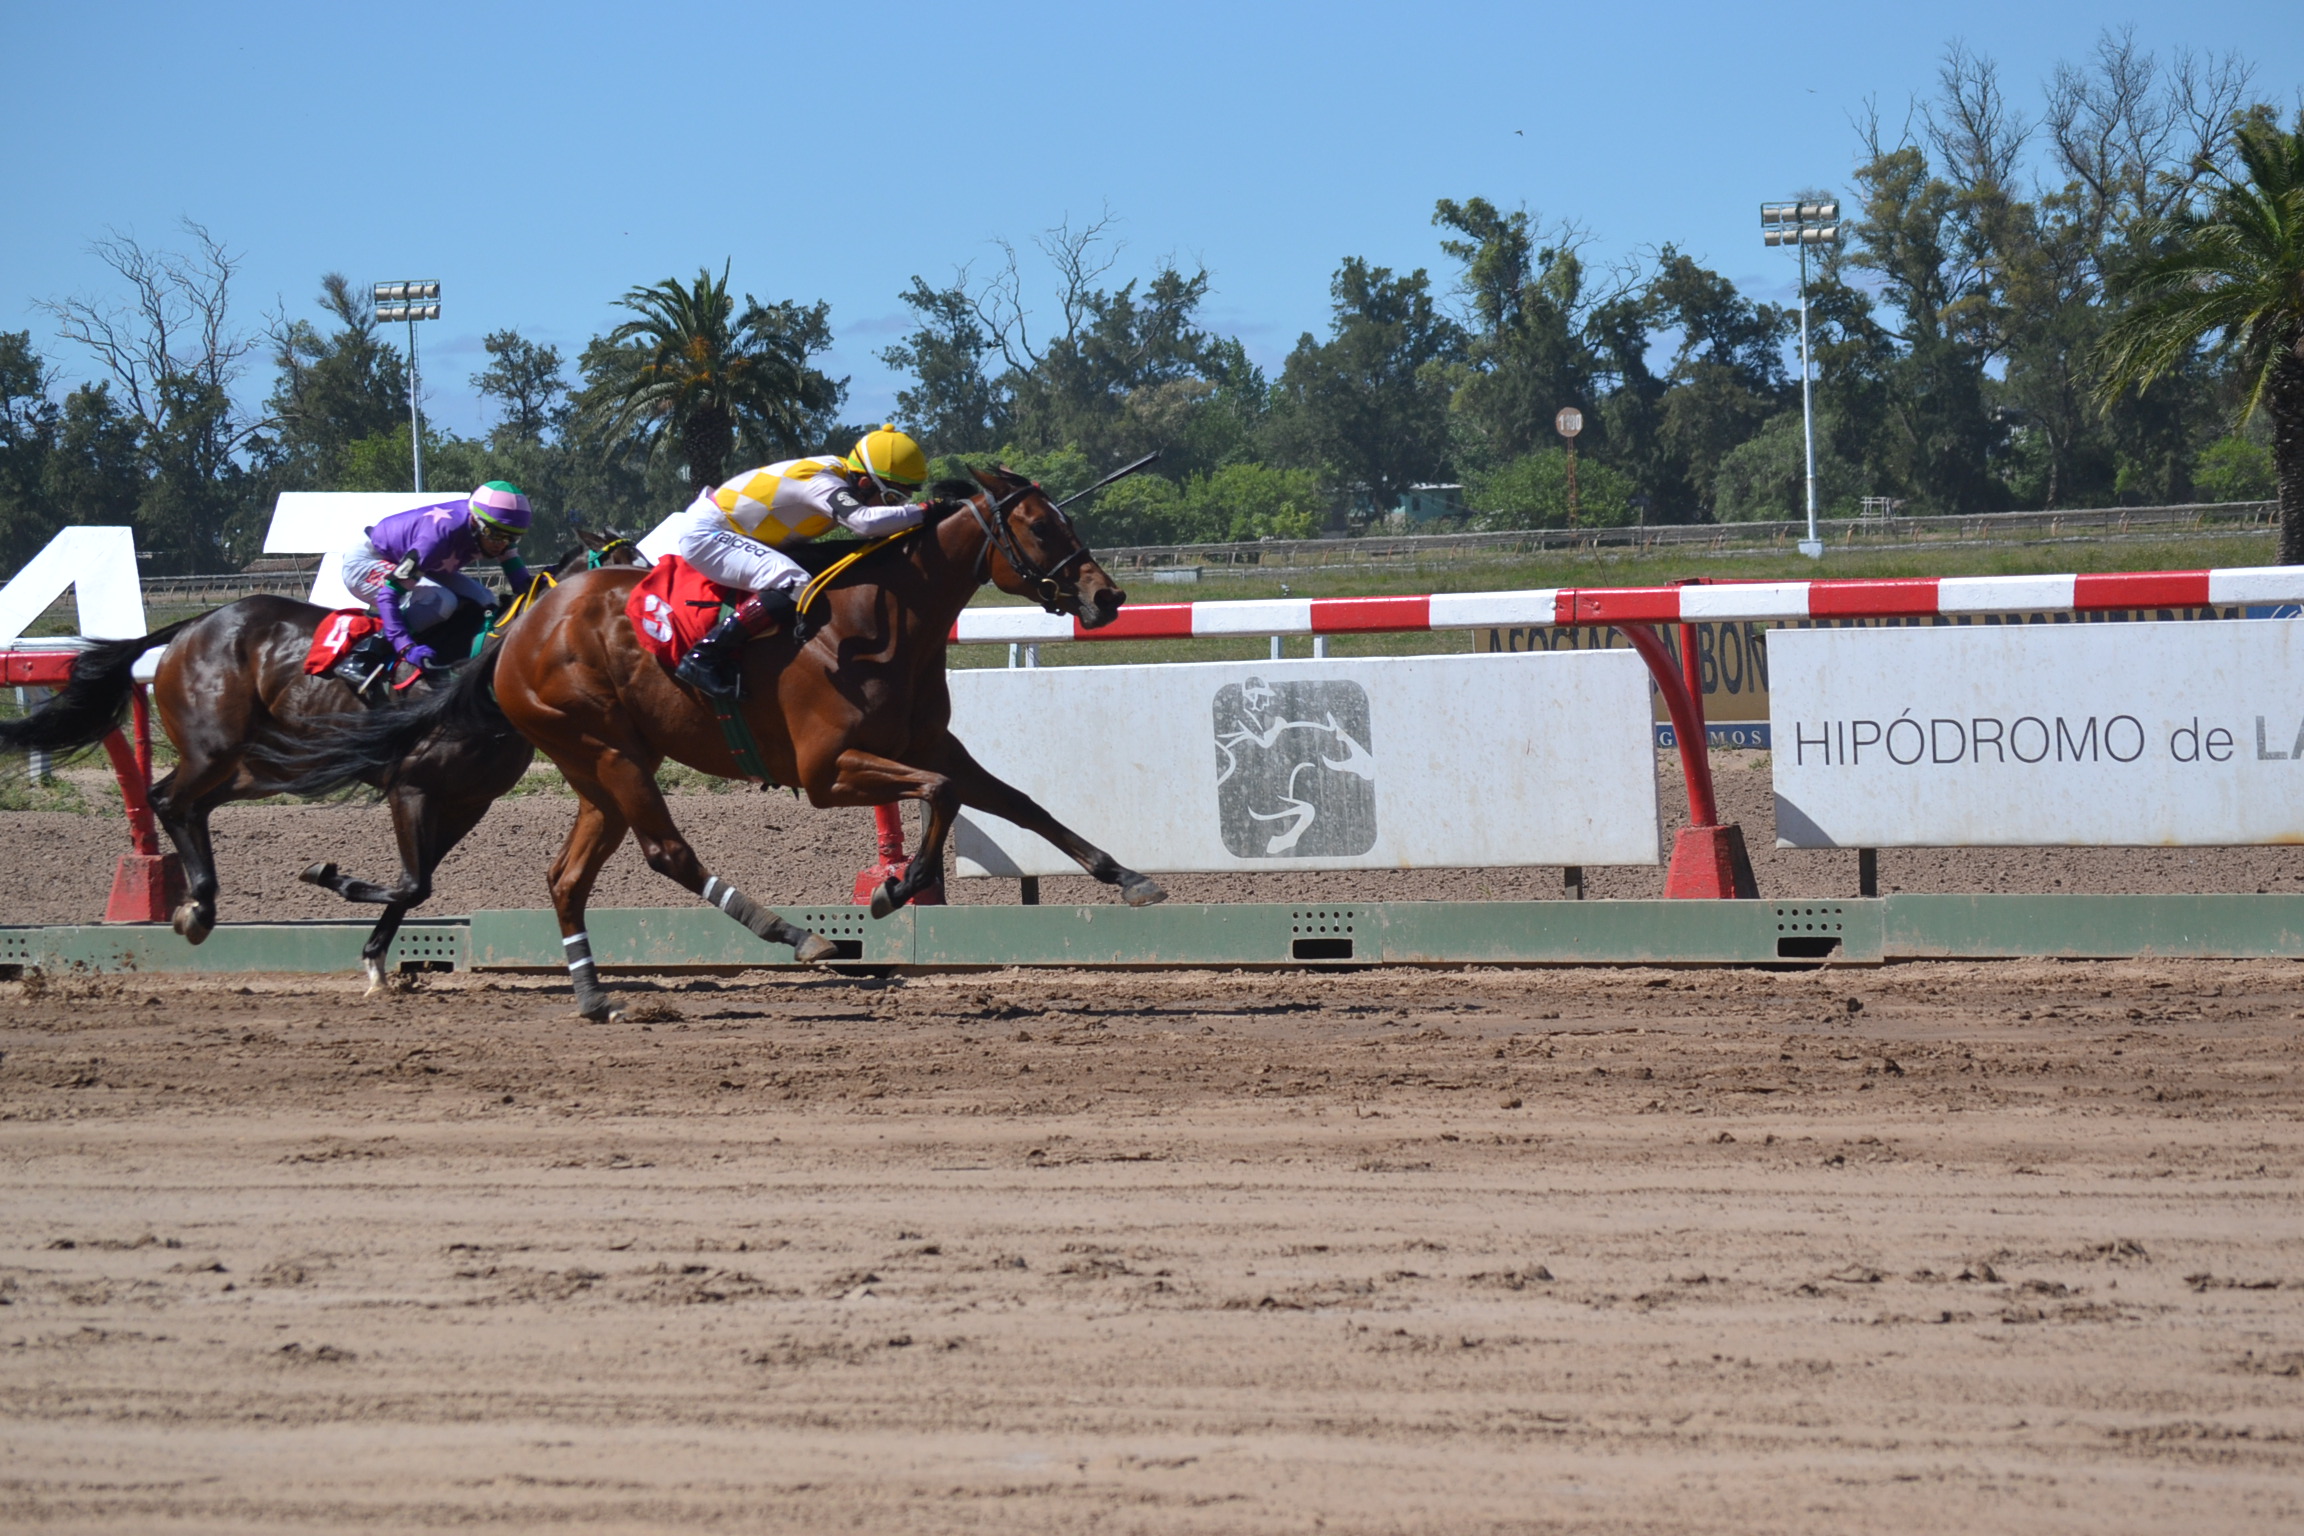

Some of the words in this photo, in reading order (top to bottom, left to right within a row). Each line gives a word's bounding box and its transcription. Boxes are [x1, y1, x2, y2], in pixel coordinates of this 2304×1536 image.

[323, 615, 353, 654] 4
[1796, 708, 2145, 765] HIPÓDROMO
[2170, 716, 2234, 762] de
